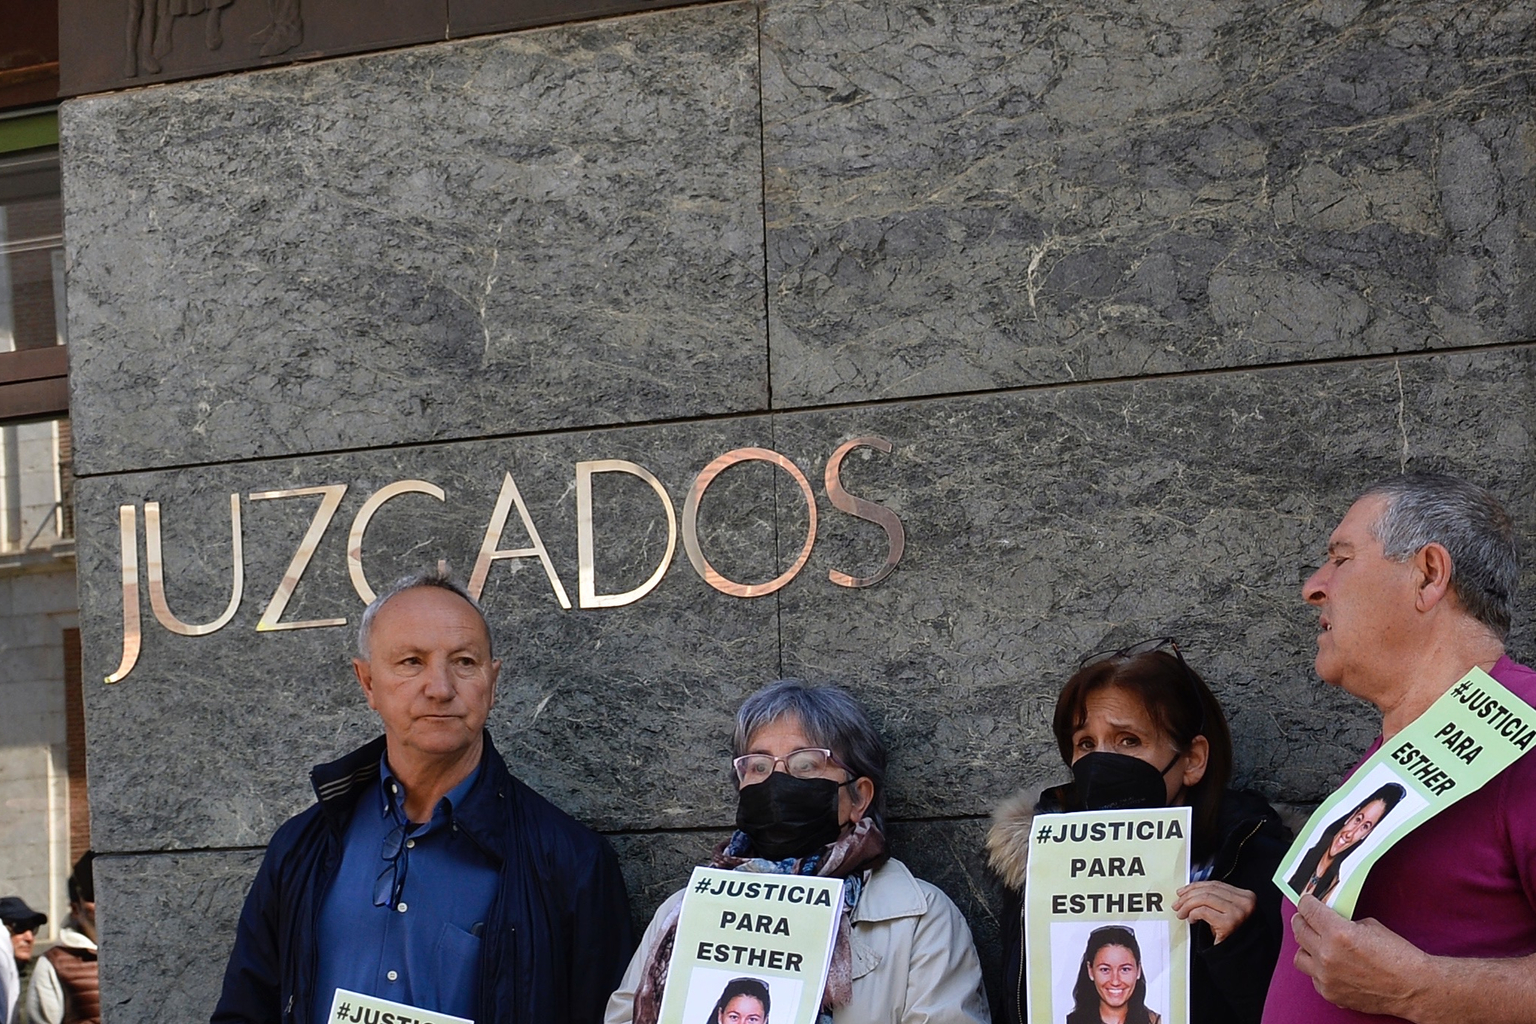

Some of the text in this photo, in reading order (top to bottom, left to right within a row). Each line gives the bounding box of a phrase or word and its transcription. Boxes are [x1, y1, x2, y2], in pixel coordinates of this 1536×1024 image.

[104, 435, 905, 684] JUZGADOS
[1433, 722, 1484, 765] PARA
[1390, 741, 1456, 797] ESTHER
[1036, 819, 1184, 844] #JUSTICIA
[1070, 856, 1146, 878] PARA
[694, 877, 832, 907] #JUSTICIA
[1052, 892, 1164, 914] ESTHER
[719, 910, 790, 937] PARA
[696, 941, 804, 972] ESTHER
